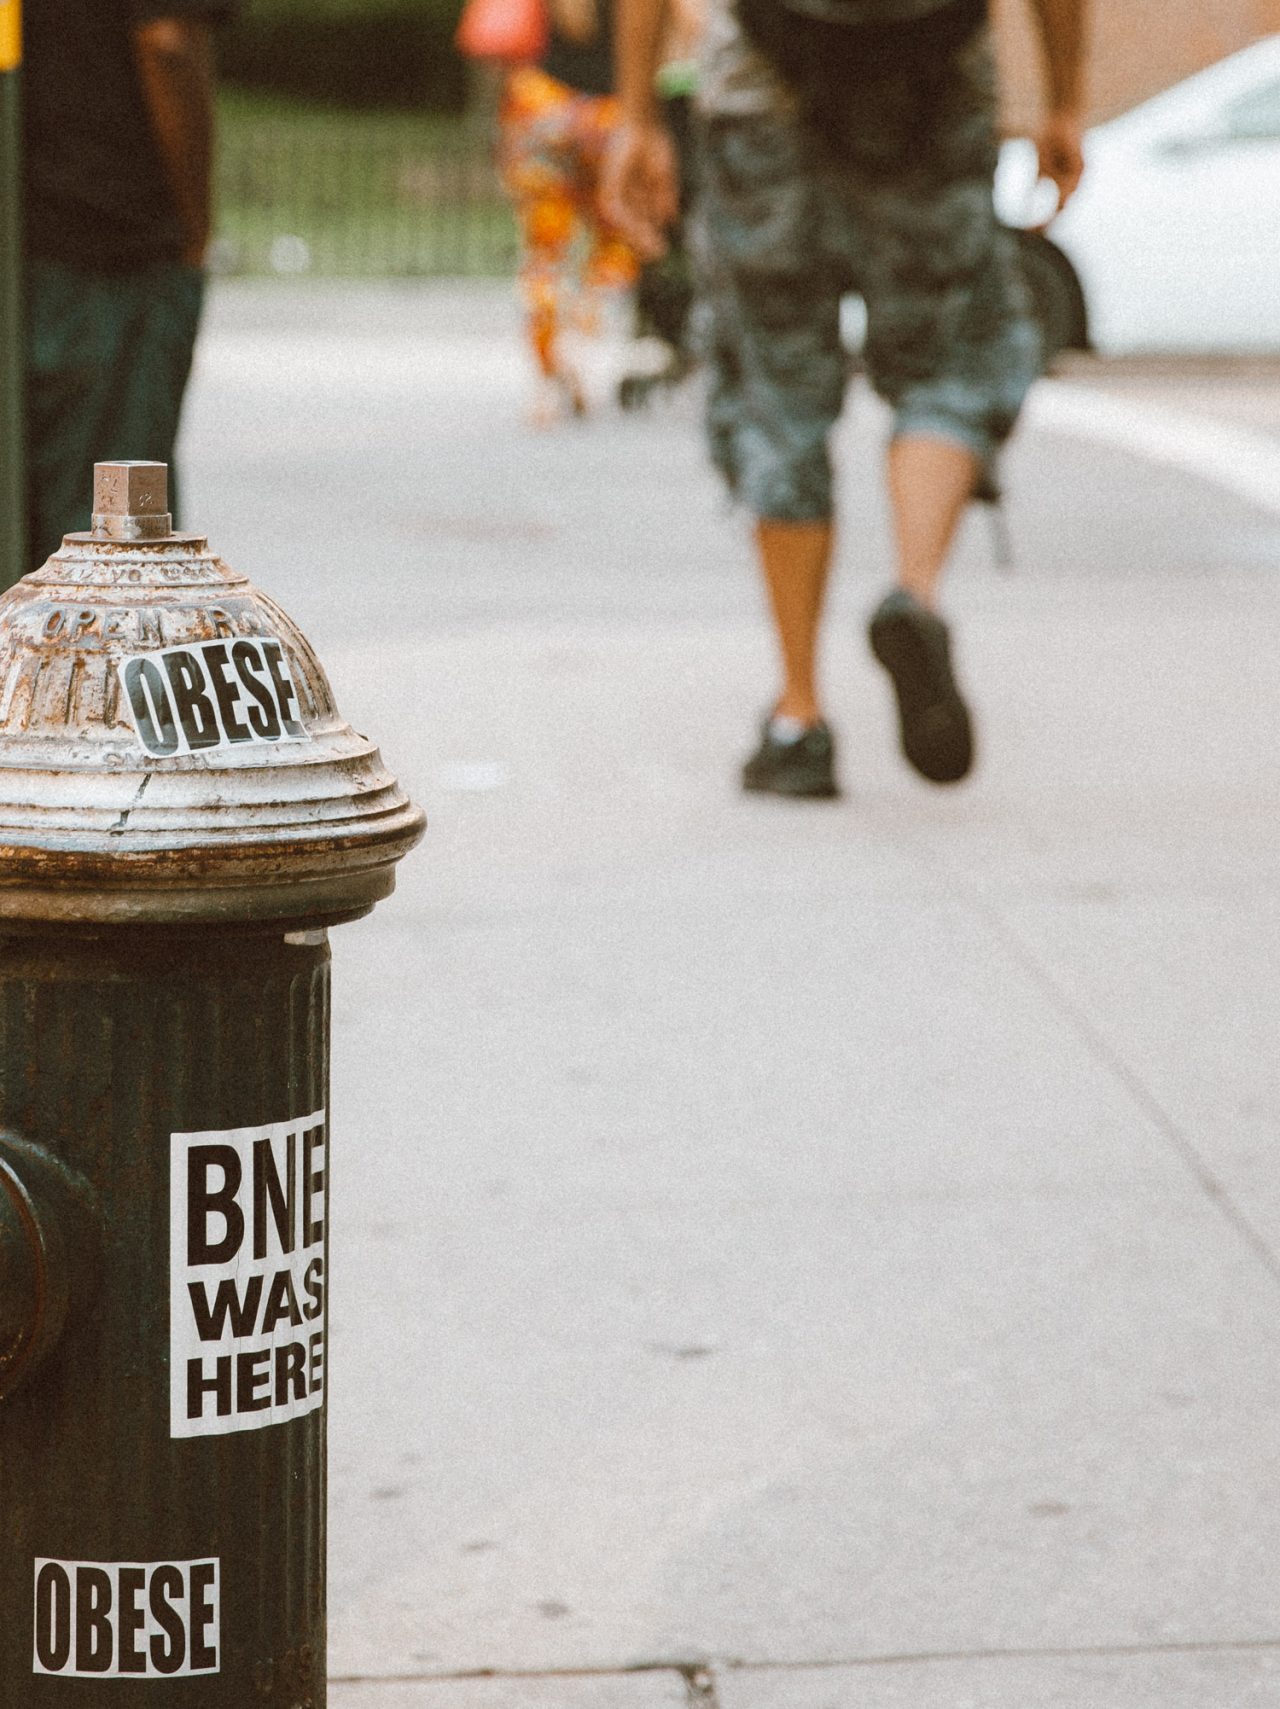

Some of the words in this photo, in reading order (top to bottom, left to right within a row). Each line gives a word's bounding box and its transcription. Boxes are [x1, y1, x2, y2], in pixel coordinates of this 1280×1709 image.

[42, 608, 163, 647] OPEN
[124, 641, 309, 756] OBESE
[187, 1123, 324, 1266] BNE
[187, 1257, 323, 1342] WAS
[187, 1331, 323, 1419] HERE
[36, 1562, 217, 1673] OBESE
